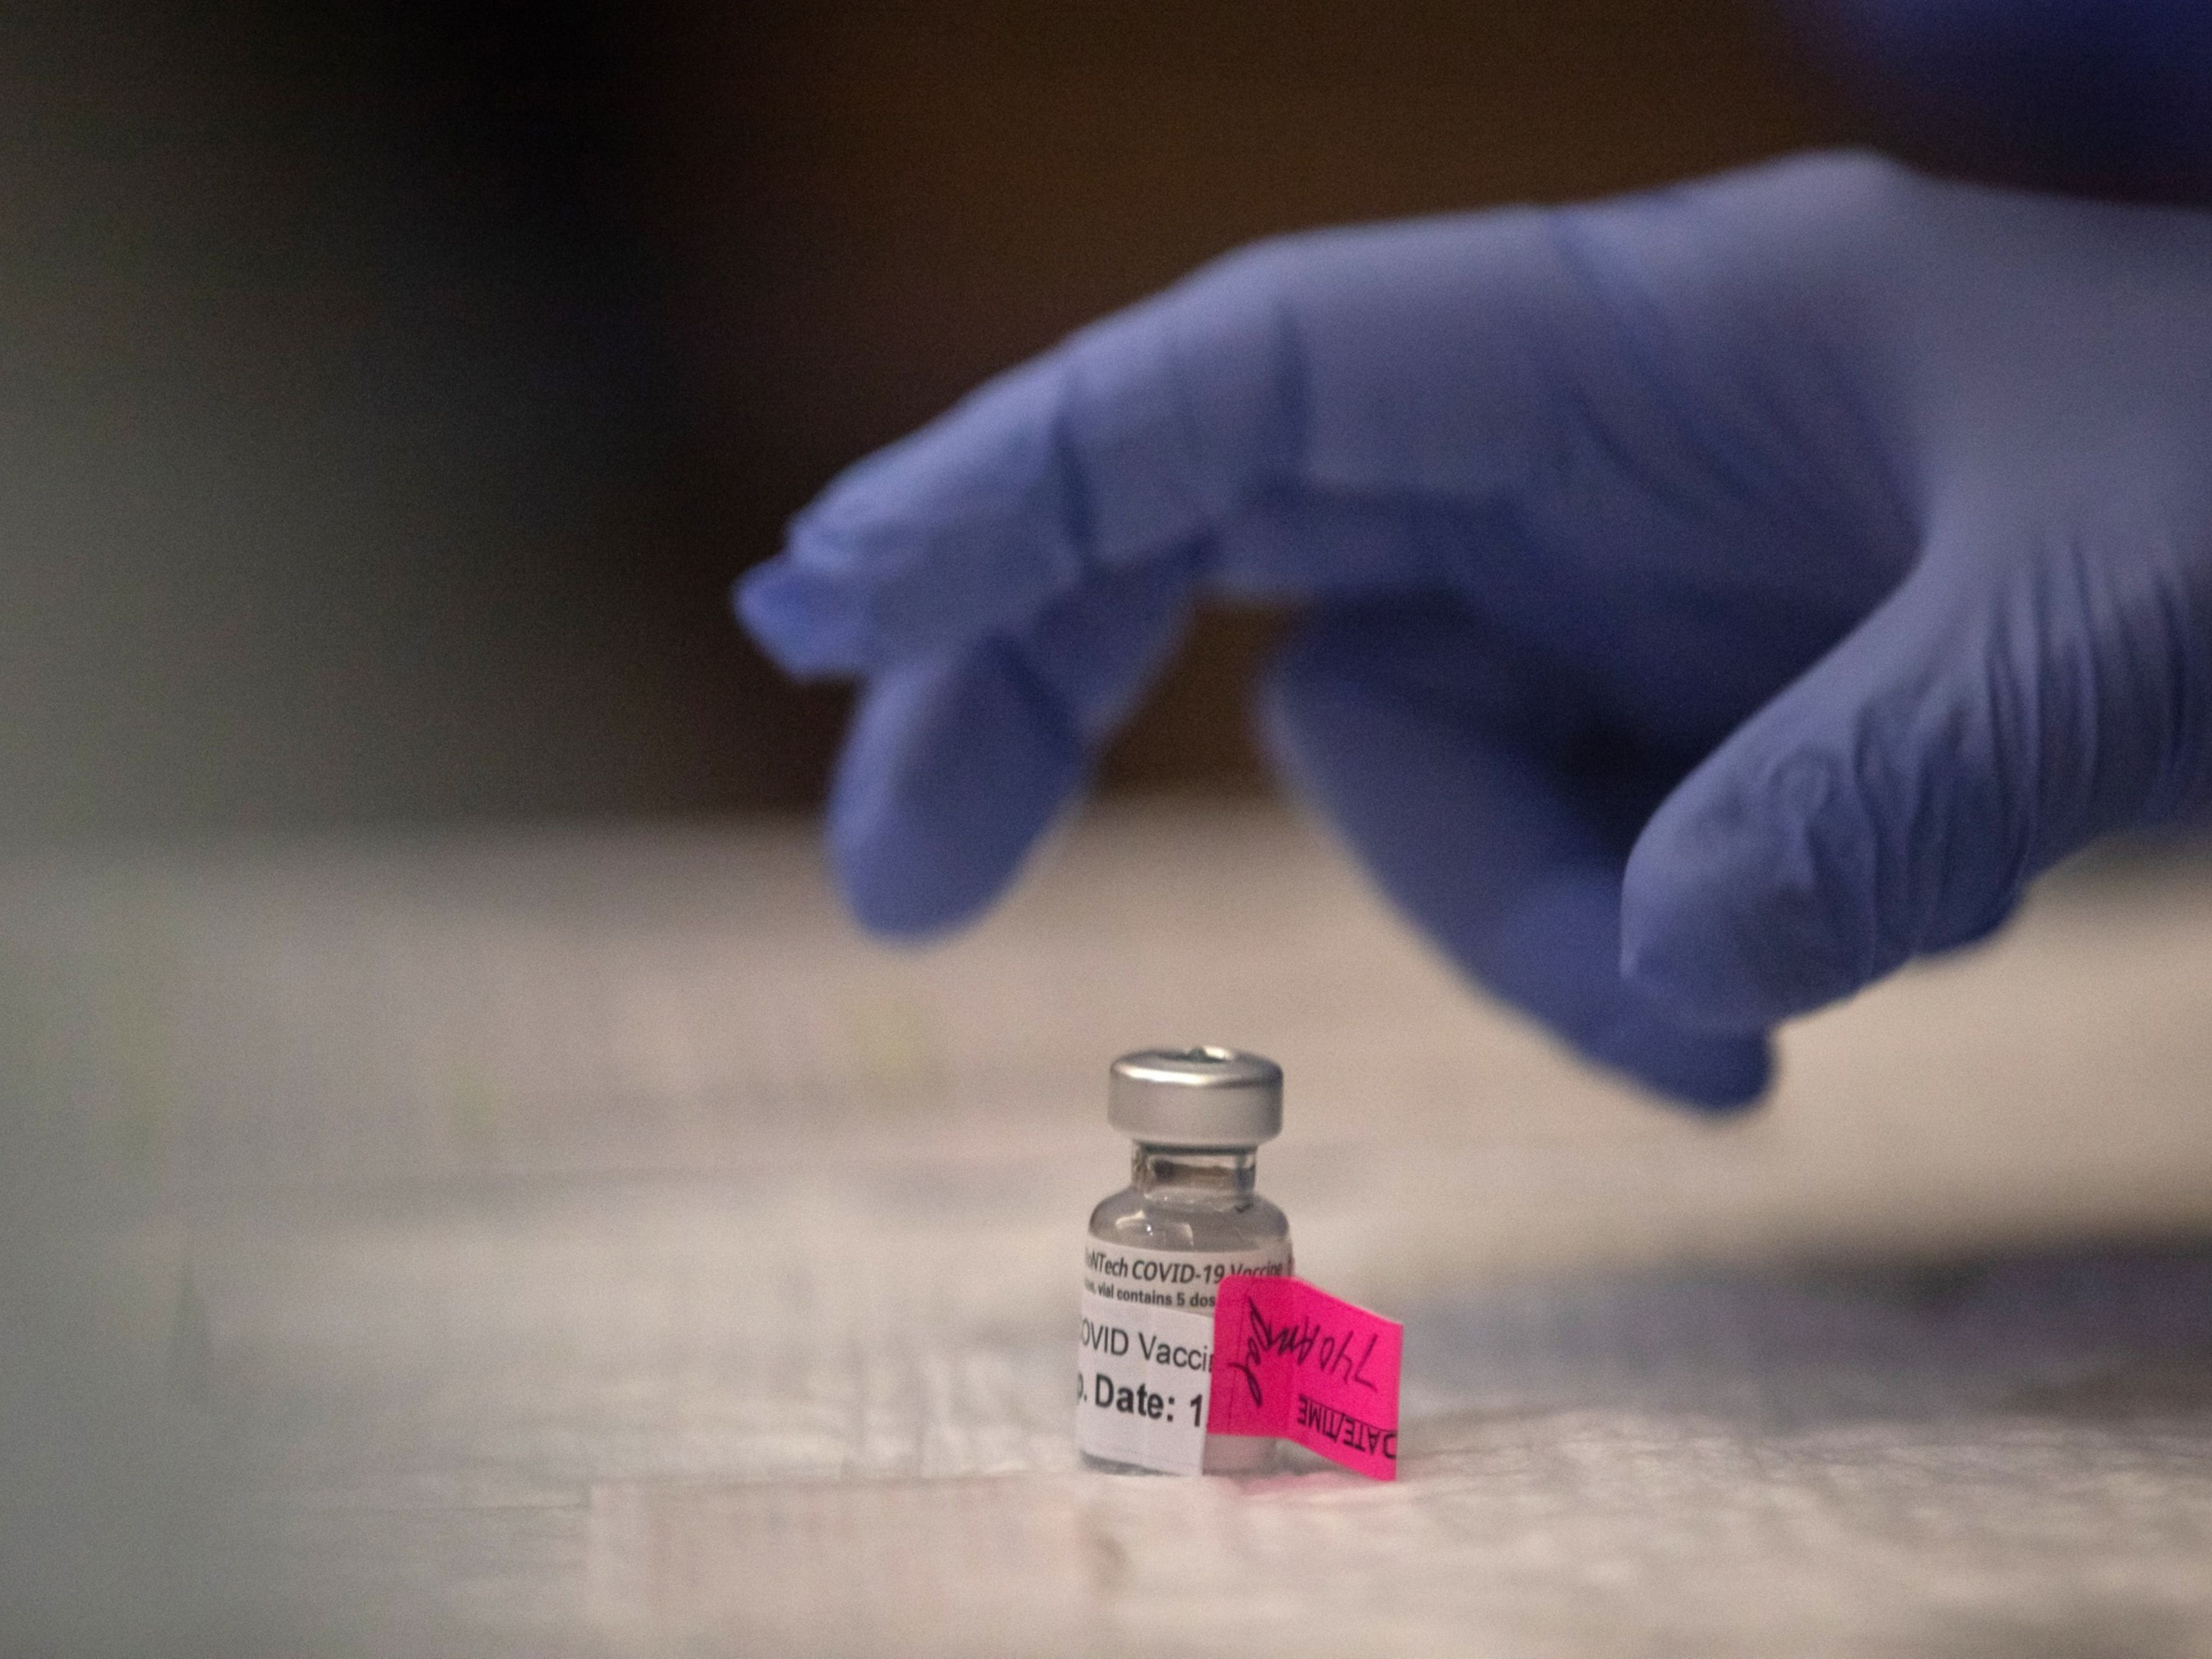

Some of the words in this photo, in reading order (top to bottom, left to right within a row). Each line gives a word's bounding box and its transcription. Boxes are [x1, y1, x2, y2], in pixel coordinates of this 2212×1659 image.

[1132, 1260, 1225, 1284] COVID-19
[1117, 1288, 1172, 1306] contains
[1177, 1293, 1185, 1306] 5
[1082, 1317, 1129, 1356] OVID
[1095, 1373, 1175, 1422] Date:
[1190, 1393, 1203, 1428] 1
[1297, 1394, 1397, 1459] DATE/TIME
